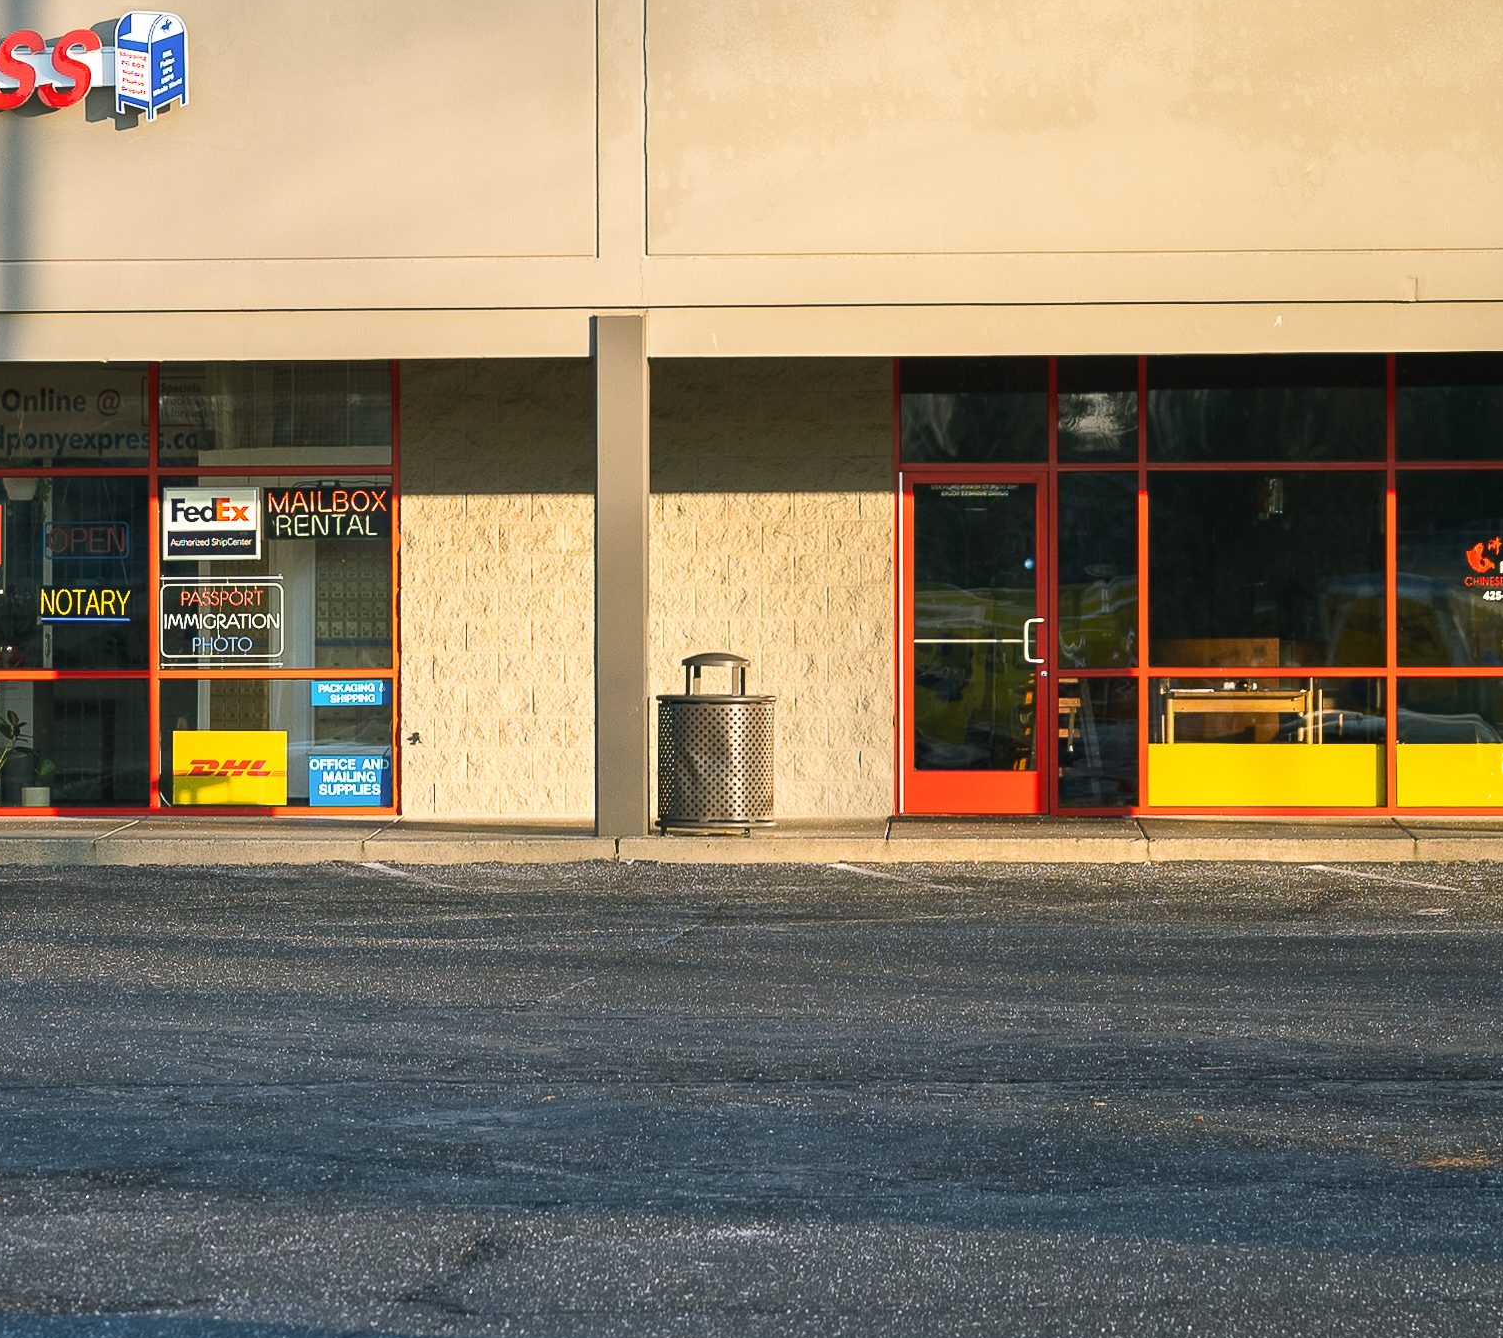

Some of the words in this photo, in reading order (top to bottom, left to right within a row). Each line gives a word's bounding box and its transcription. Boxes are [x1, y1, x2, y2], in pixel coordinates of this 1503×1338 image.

[1, 388, 87, 413] Online
[171, 497, 250, 522] FedEx
[268, 491, 388, 513] MAILBOX
[276, 514, 378, 536] RENTAL
[48, 527, 125, 553] OPEN
[170, 537, 210, 547] Authorized
[211, 537, 253, 548] ShipCenter
[40, 588, 131, 616] NOTARY
[181, 589, 264, 606] PASSPORT
[164, 613, 280, 630] IMMIGRATION
[192, 636, 253, 652] PHOTO
[318, 683, 376, 694] PACKAGING
[329, 694, 376, 704] SHIPPING
[186, 759, 273, 777] DHL
[309, 758, 356, 770] OFFICE
[361, 758, 390, 770] AND
[322, 771, 377, 783] MAILING
[318, 783, 382, 795] SUPPLIES
